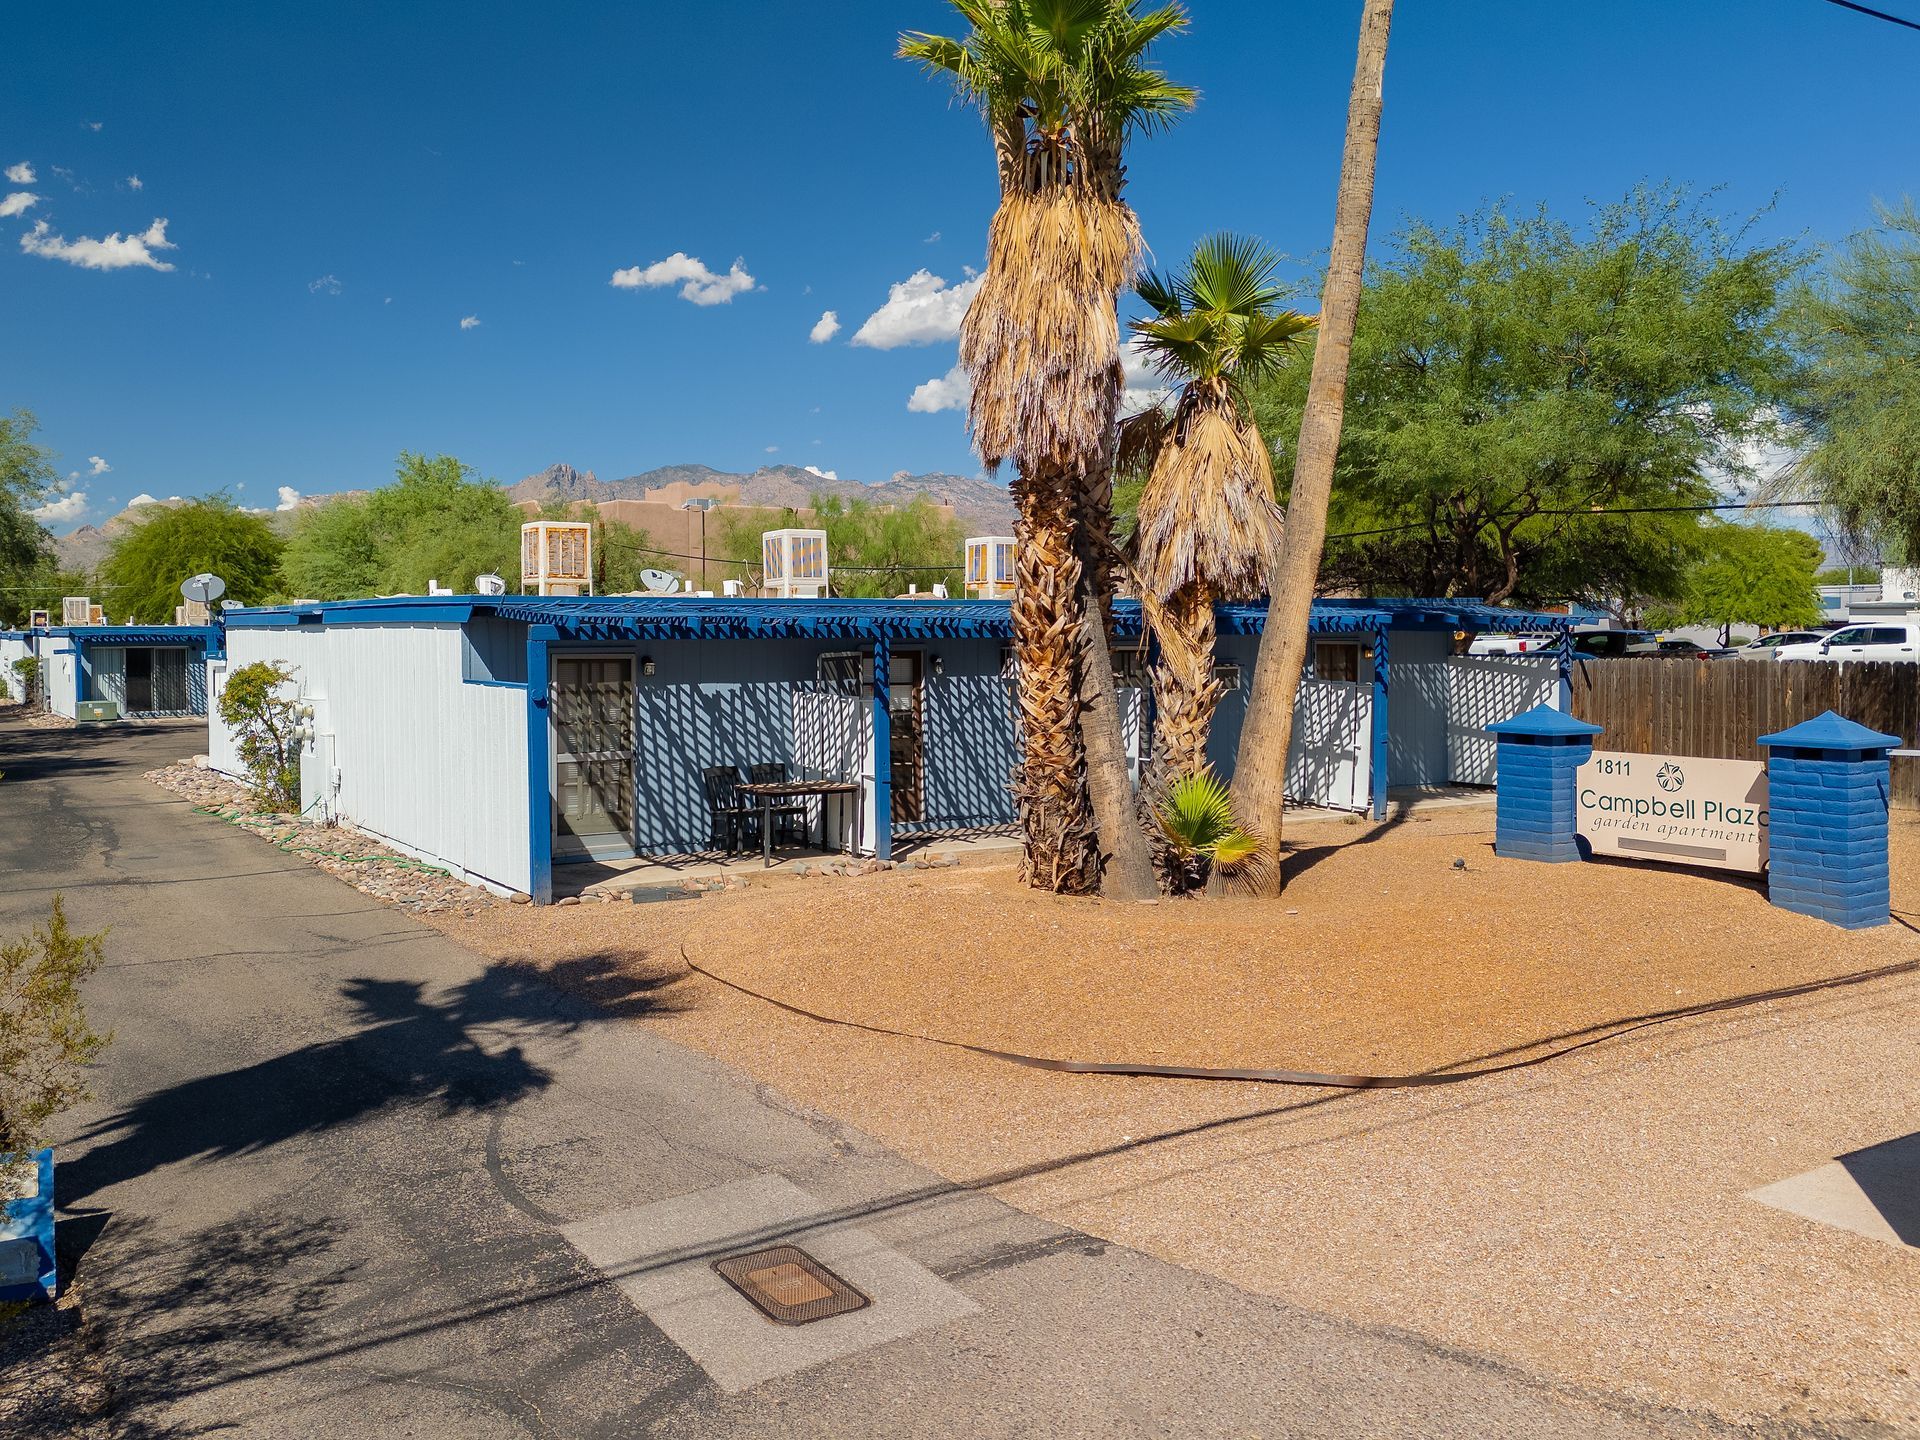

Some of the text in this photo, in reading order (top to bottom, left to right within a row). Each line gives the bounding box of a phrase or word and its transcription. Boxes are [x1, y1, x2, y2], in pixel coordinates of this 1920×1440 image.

[1596, 758, 1630, 776] 1811
[1580, 789, 1695, 819] Campbell
[1590, 815, 1763, 844] garden apartments
